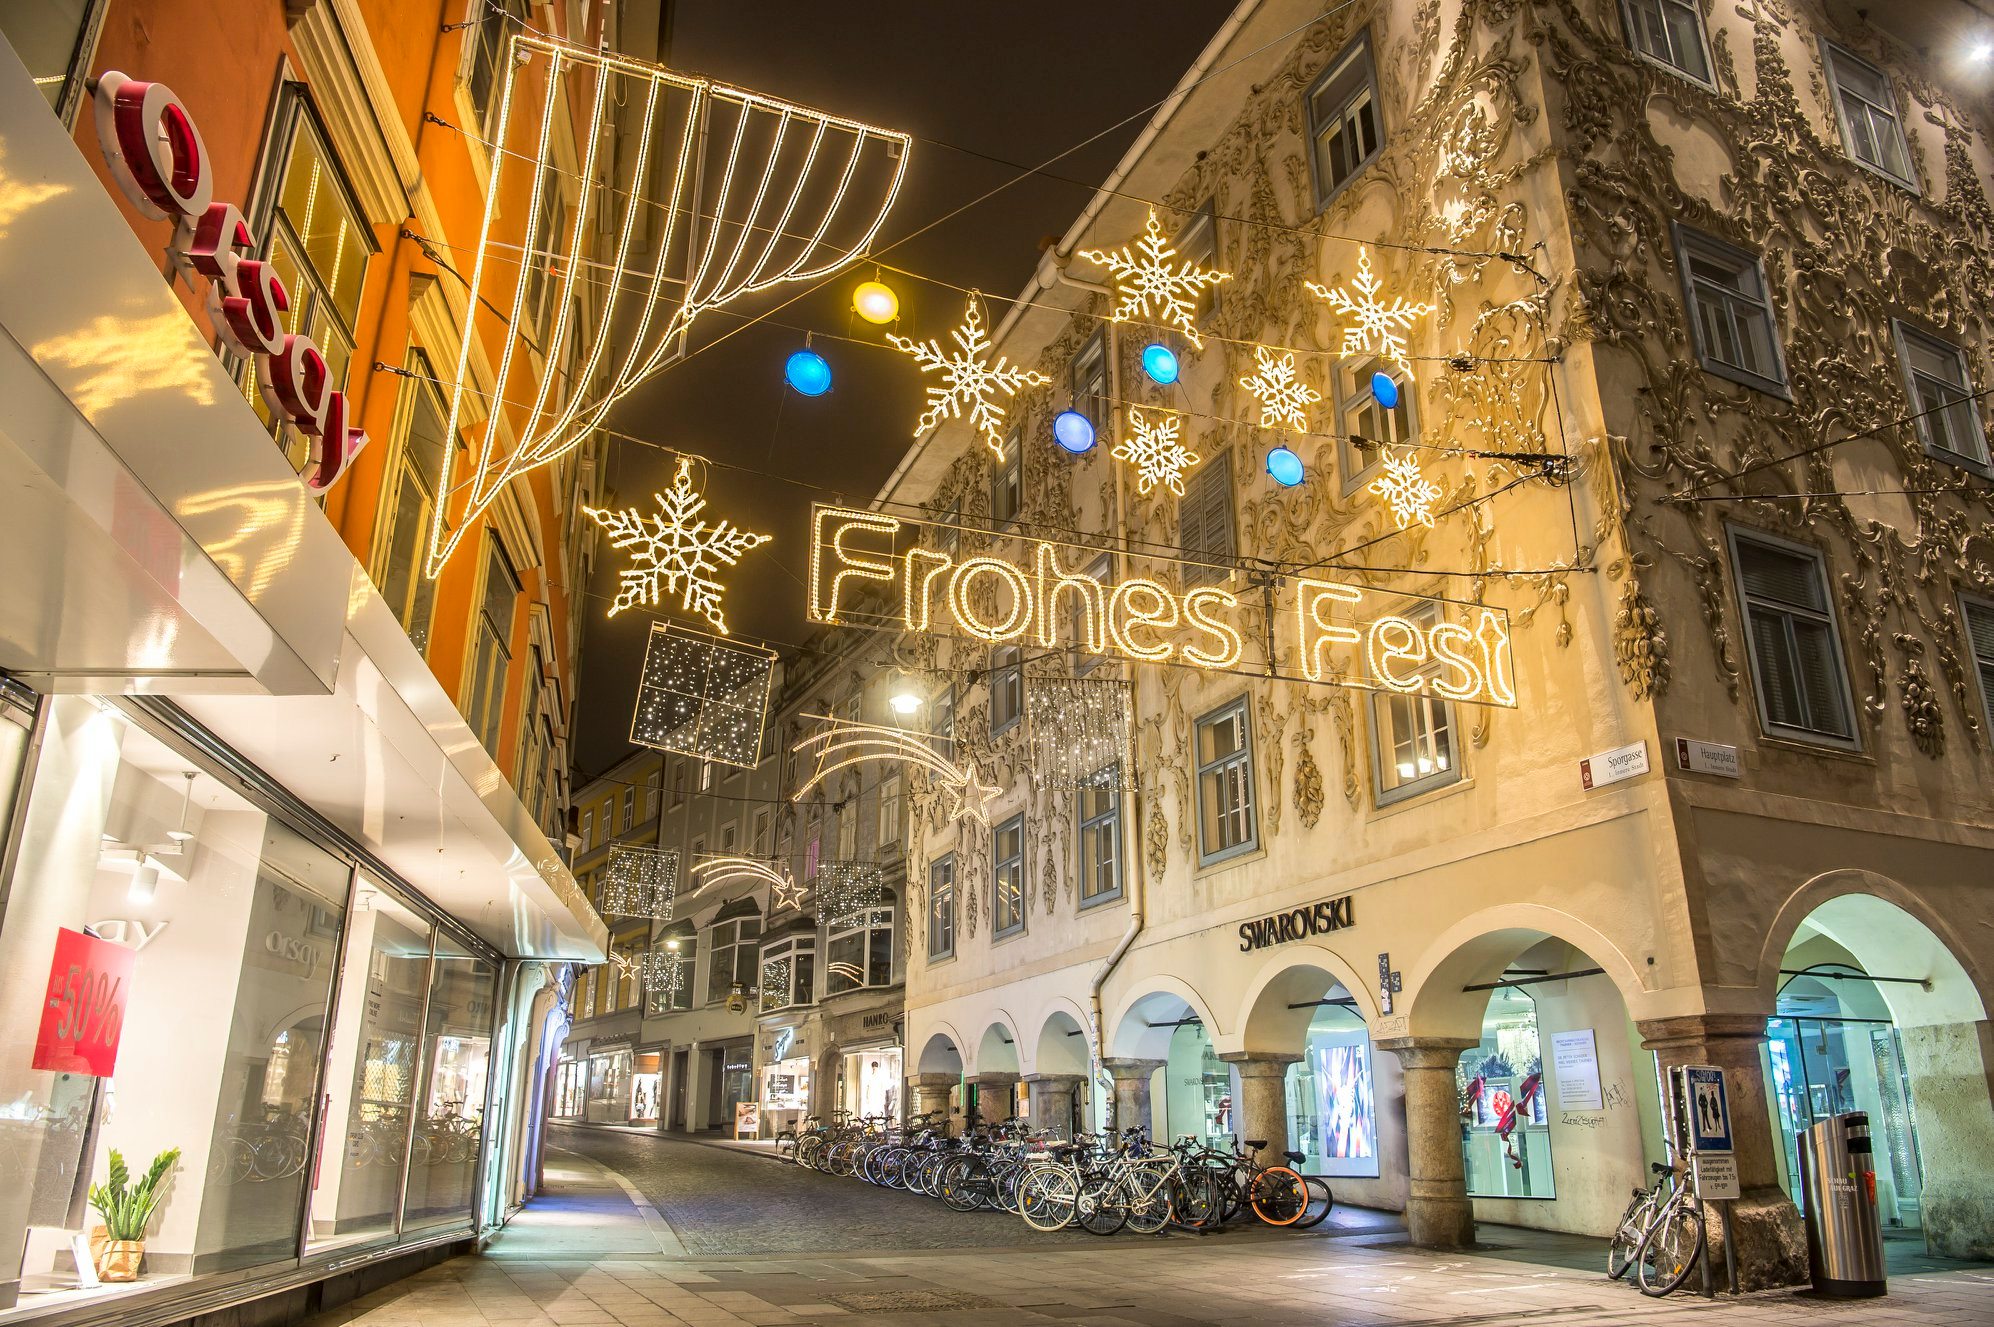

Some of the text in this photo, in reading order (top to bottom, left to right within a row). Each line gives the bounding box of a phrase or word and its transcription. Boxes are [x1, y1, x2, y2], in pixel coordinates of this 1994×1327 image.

[813, 508, 1517, 708] Frohes Fest
[1607, 750, 1643, 769] Sporgasse
[1700, 747, 1736, 764] Hauptplatz
[1239, 896, 1354, 952] SWAROVSKI
[863, 1012, 889, 1028] HANRO
